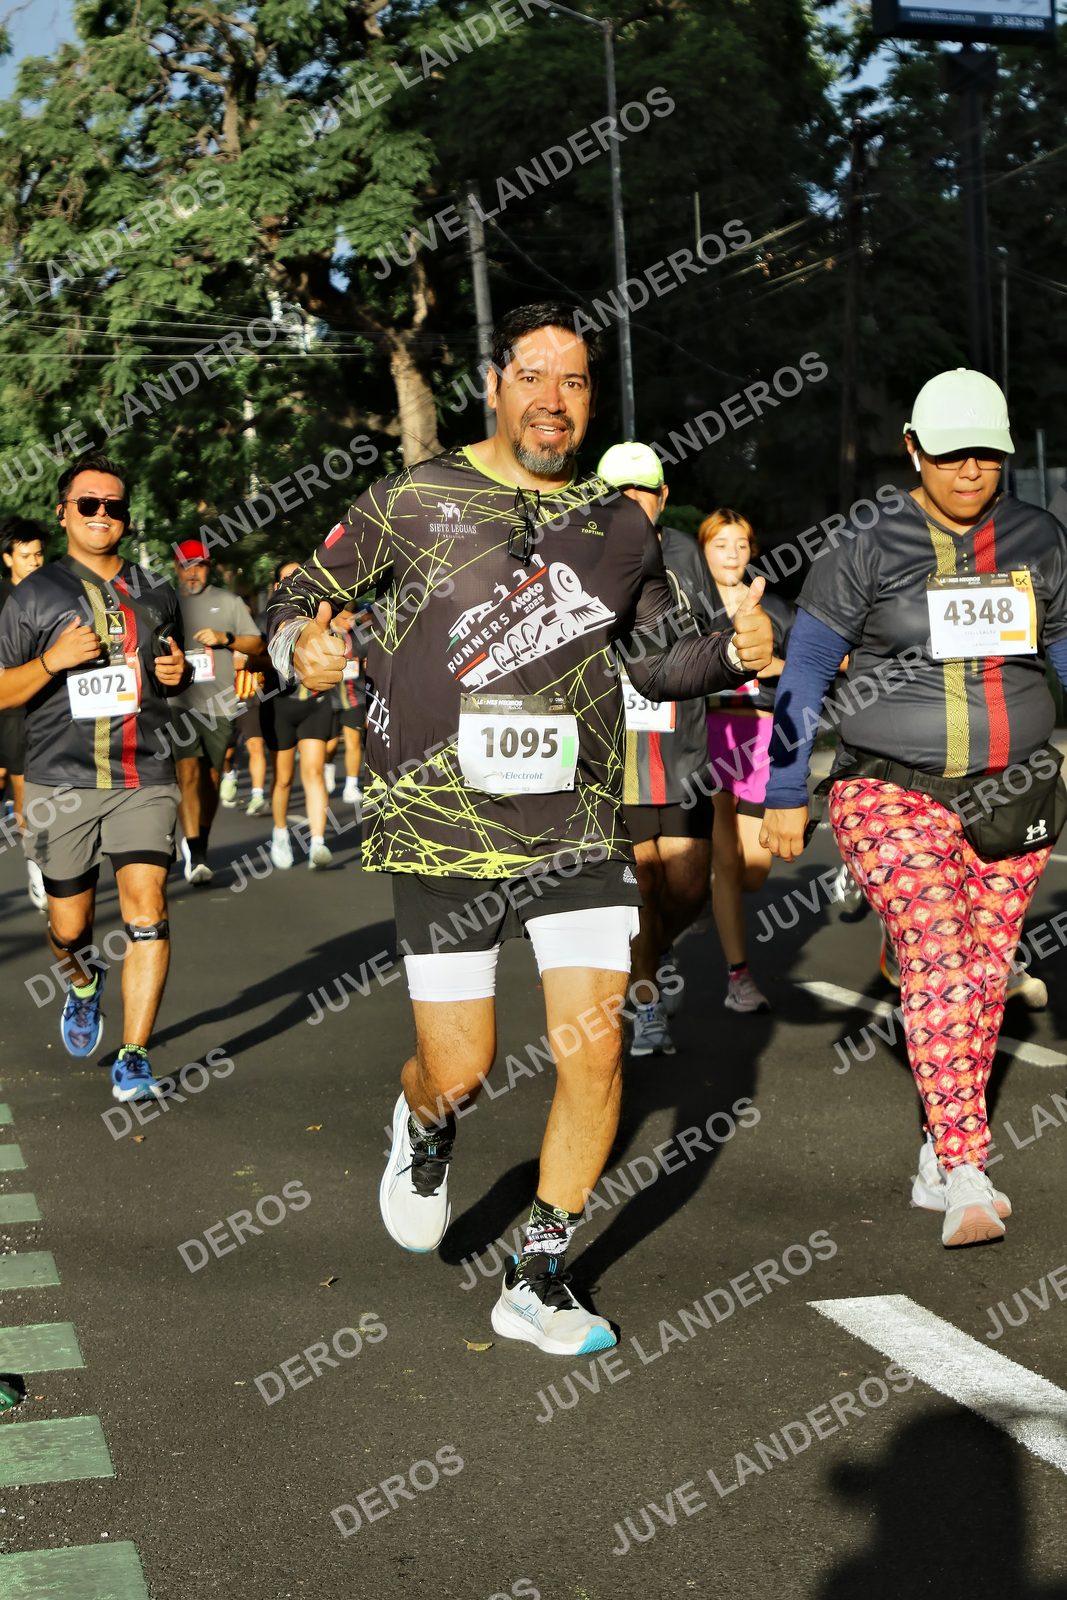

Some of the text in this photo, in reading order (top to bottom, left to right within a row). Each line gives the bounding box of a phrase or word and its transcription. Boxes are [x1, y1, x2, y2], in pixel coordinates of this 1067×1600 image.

[429, 523, 477, 534] SIETE LEGUAS
[523, 594, 546, 614] 2025
[943, 597, 1014, 626] 4348
[447, 612, 510, 674] RUNNERS
[77, 673, 127, 696] 8072
[481, 727, 558, 758] 1095
